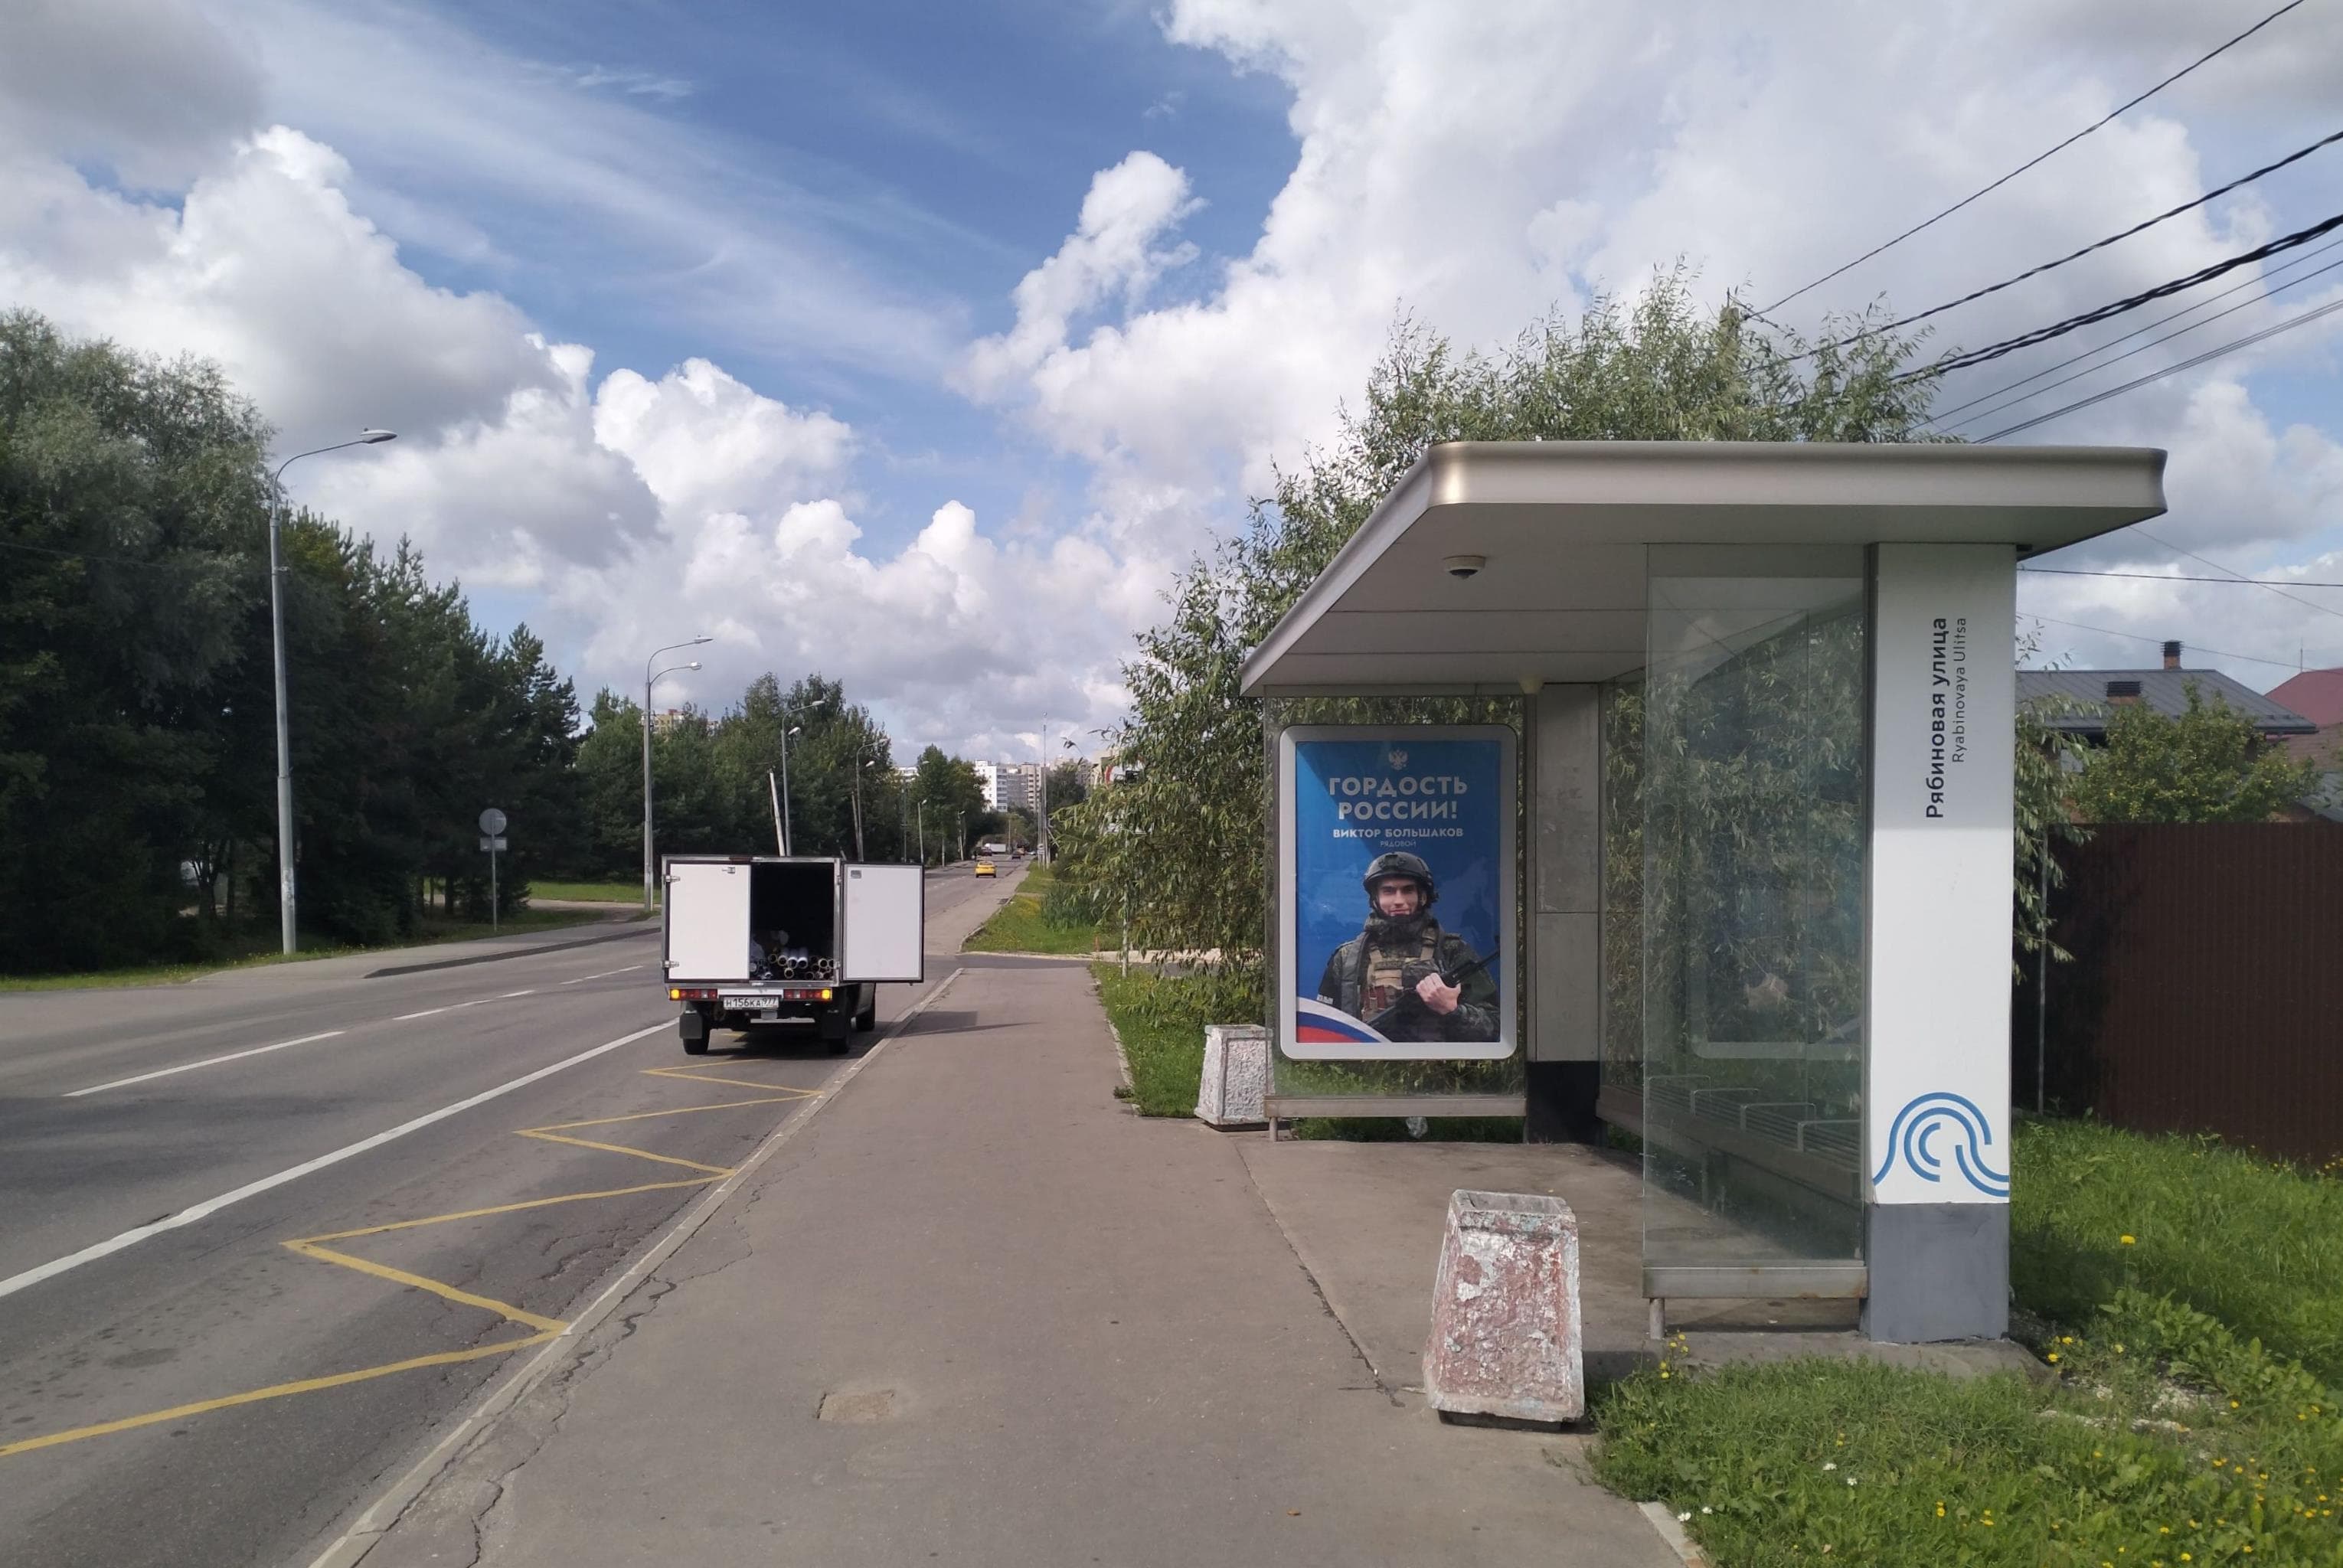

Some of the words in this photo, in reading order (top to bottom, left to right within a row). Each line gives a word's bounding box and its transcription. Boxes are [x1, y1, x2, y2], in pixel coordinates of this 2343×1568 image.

[1932, 618, 1950, 687] улица
[1953, 618, 1967, 662] Ulitsa
[1952, 666, 1969, 763] Ryabinovaya
[1926, 693, 1946, 818] Рябиновая
[1328, 776, 1469, 798] ГОРДОСТЬ
[1332, 828, 1381, 838] ВИКТОР
[1384, 828, 1464, 838] БОЛЬШАКОВ
[1338, 801, 1458, 821] РОССИИ!
